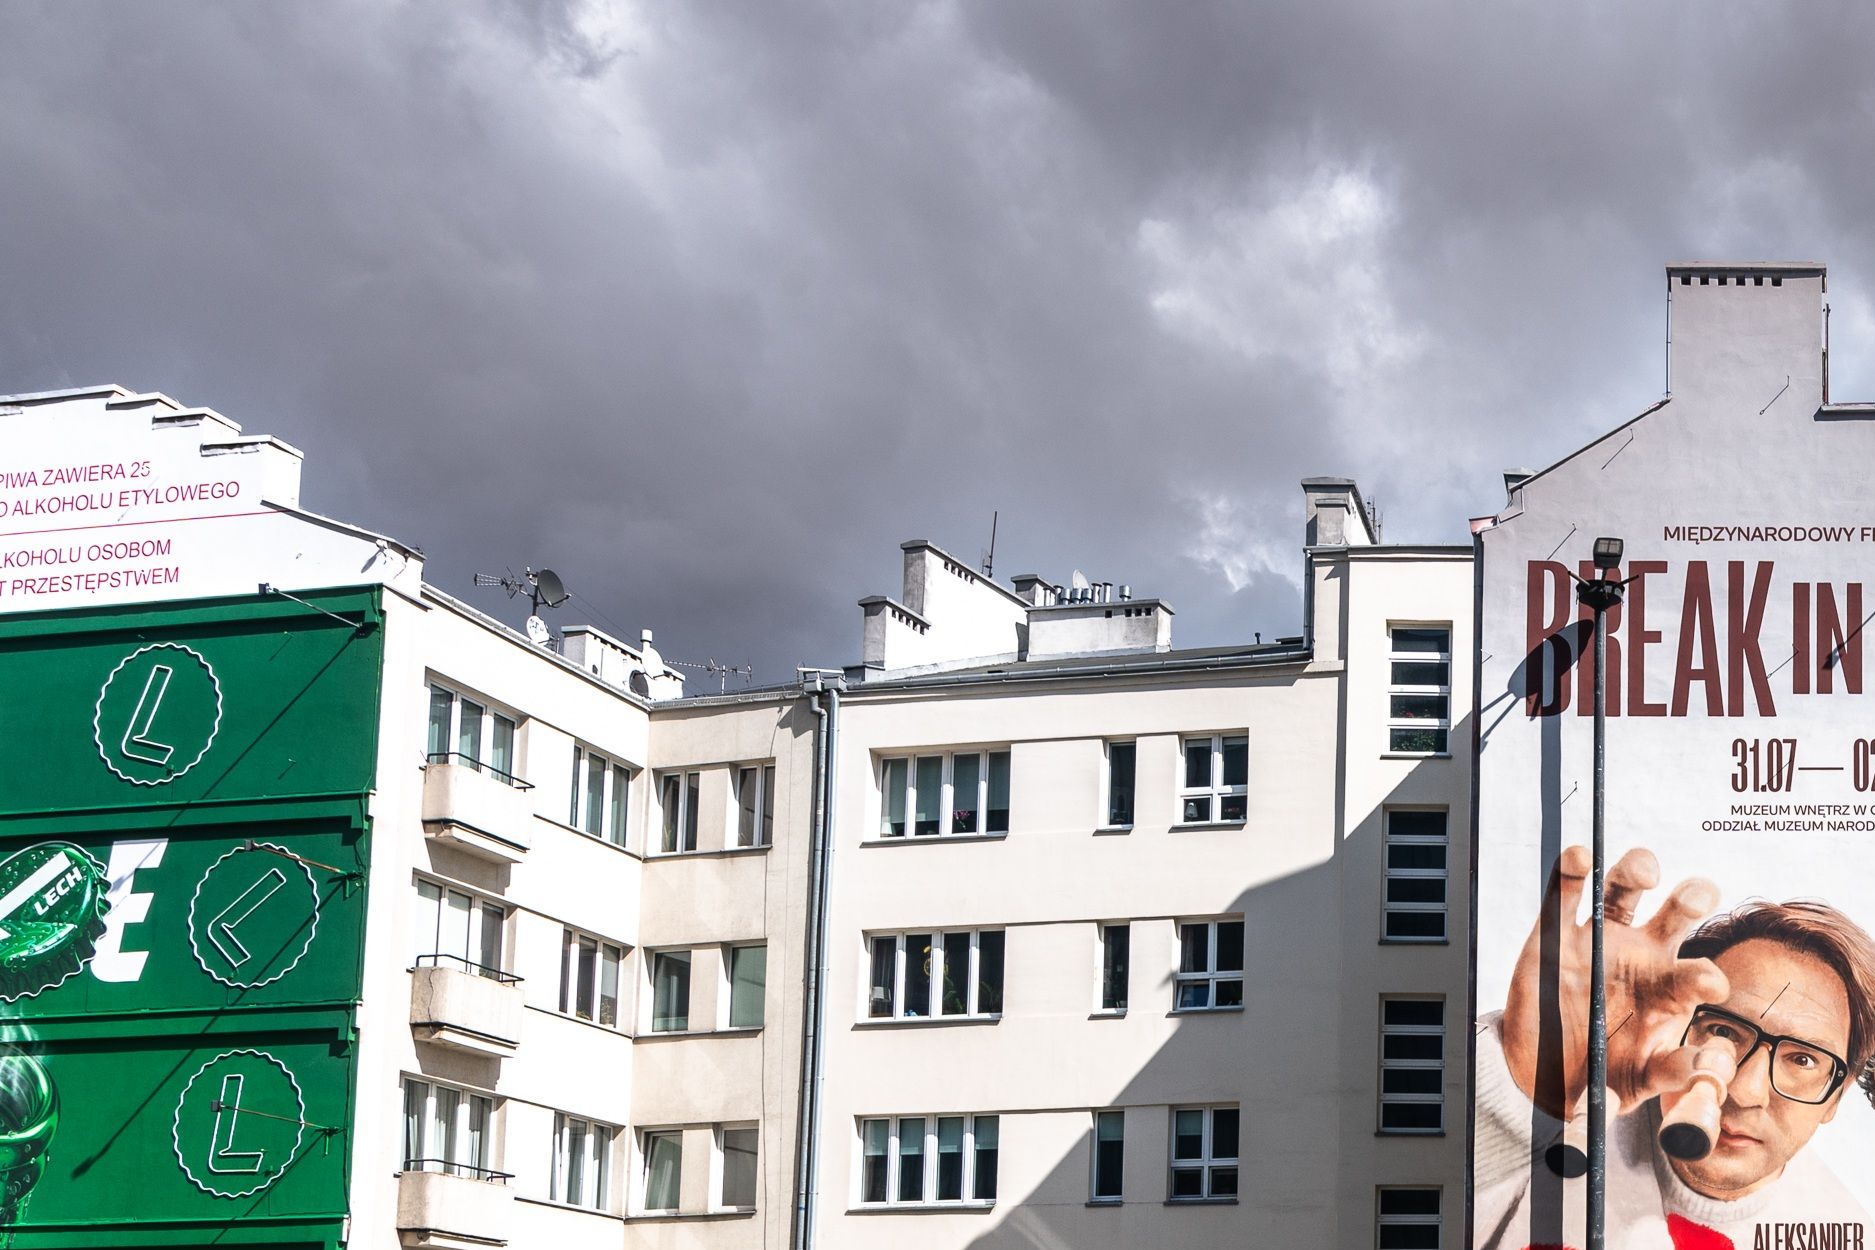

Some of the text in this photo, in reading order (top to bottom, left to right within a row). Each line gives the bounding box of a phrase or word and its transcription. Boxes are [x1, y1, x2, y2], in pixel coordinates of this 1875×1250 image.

[42, 463, 126, 486] ZAWIERA
[12, 492, 113, 516] ALKOHOLU
[119, 481, 240, 507] ETYLOWEGO
[1664, 526, 1855, 546] MIĘDZYNARODOWY
[0, 539, 171, 569] KOHOLU OSOBOM
[11, 567, 180, 595] PRZESTĘPSTWEM
[1525, 560, 1777, 718] BREAK
[1792, 582, 1864, 696] IN
[1731, 804, 1791, 816] MUZEUM
[1794, 804, 1850, 819] WNĘTRZ
[1853, 804, 1867, 816] W
[1701, 820, 1761, 832] ODDZIAŁ
[1764, 820, 1824, 832] MUZEUM
[34, 866, 83, 916] LECH
